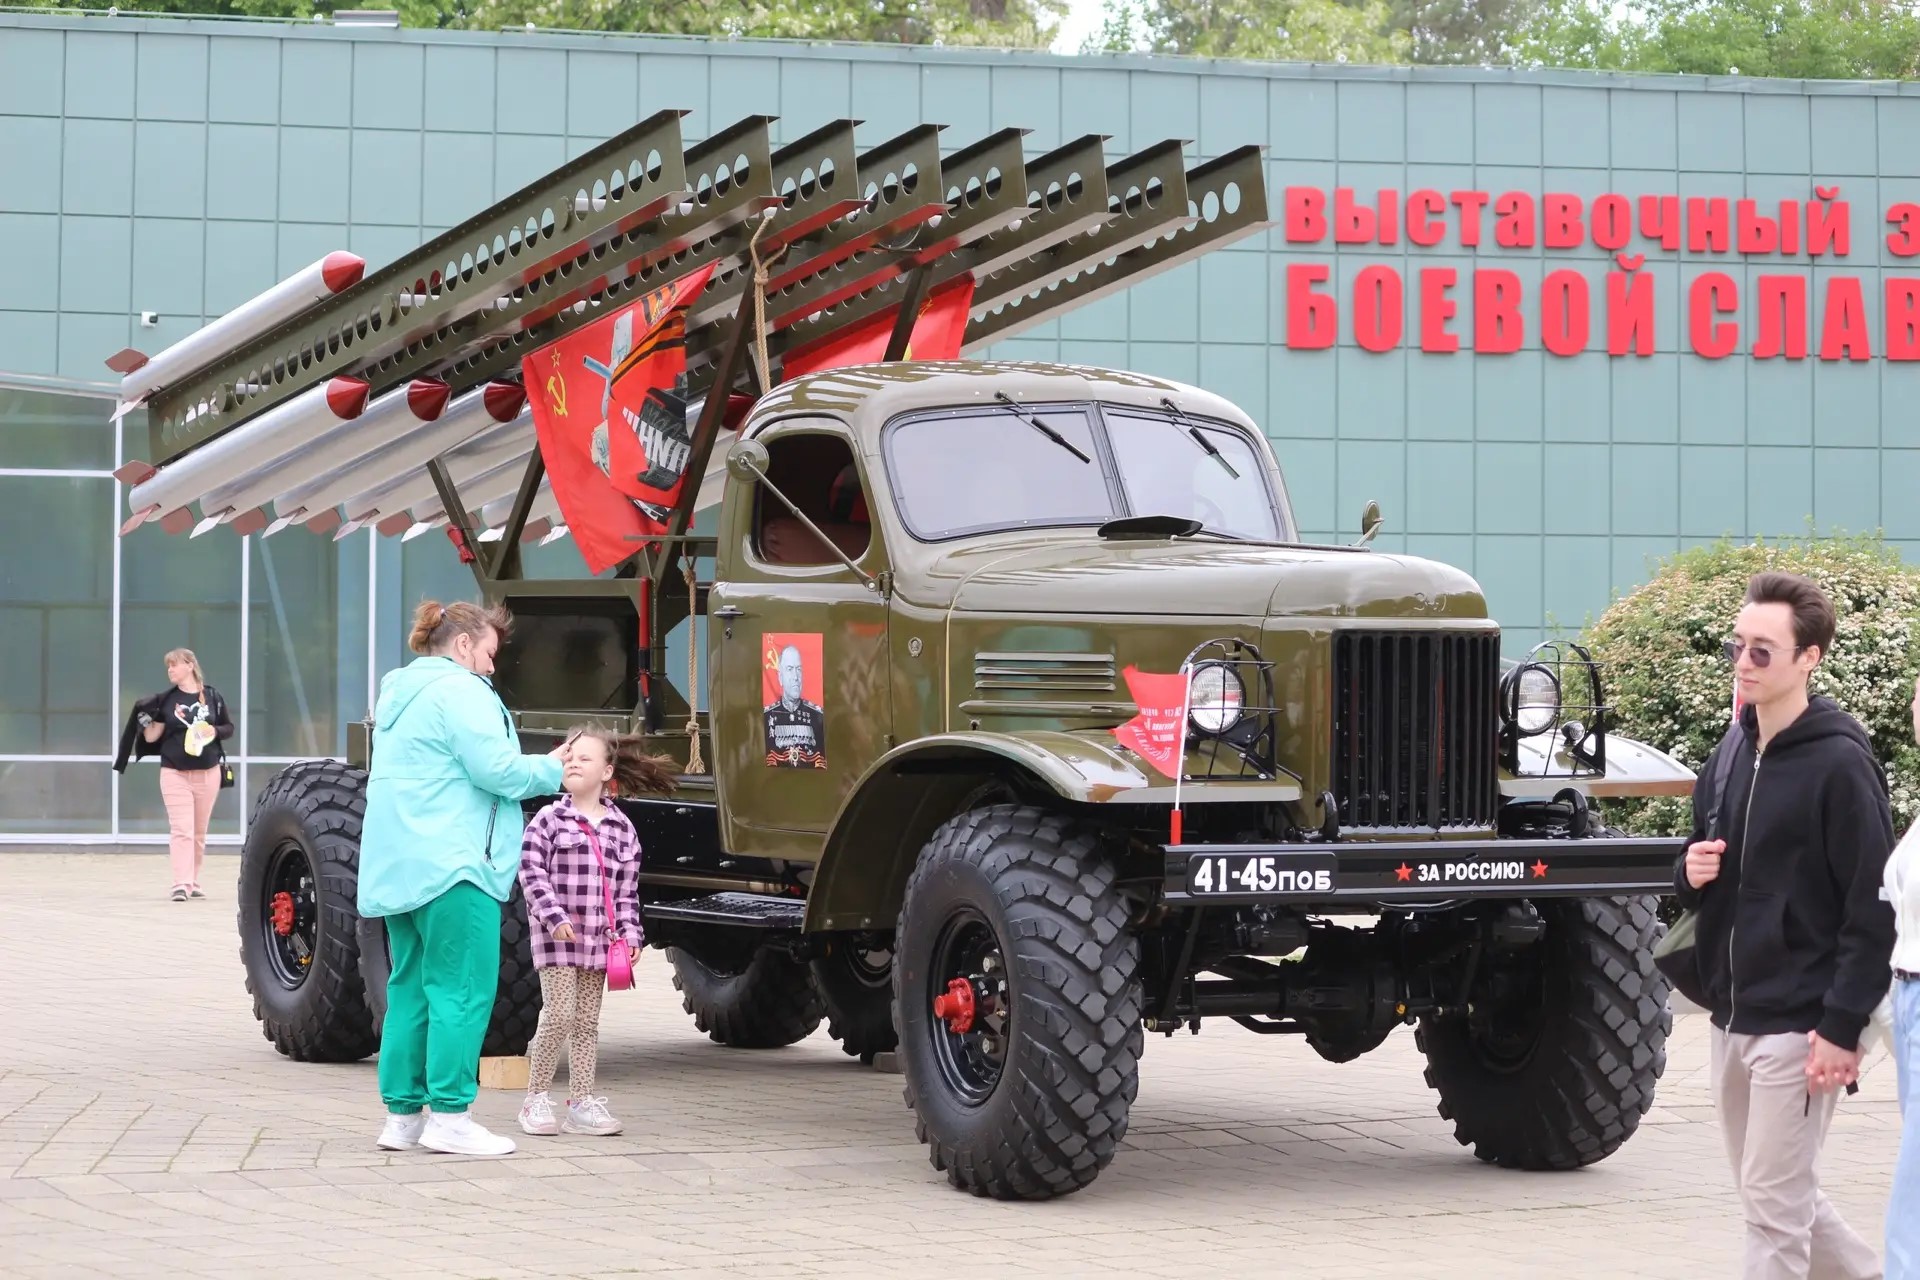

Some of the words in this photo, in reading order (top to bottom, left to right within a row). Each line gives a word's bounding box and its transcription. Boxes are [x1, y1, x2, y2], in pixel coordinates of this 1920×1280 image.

[1286, 252, 1655, 357] БОЕВОЙ
[1417, 863, 1441, 882] ЗА
[1444, 861, 1525, 881] РОССИЮ!
